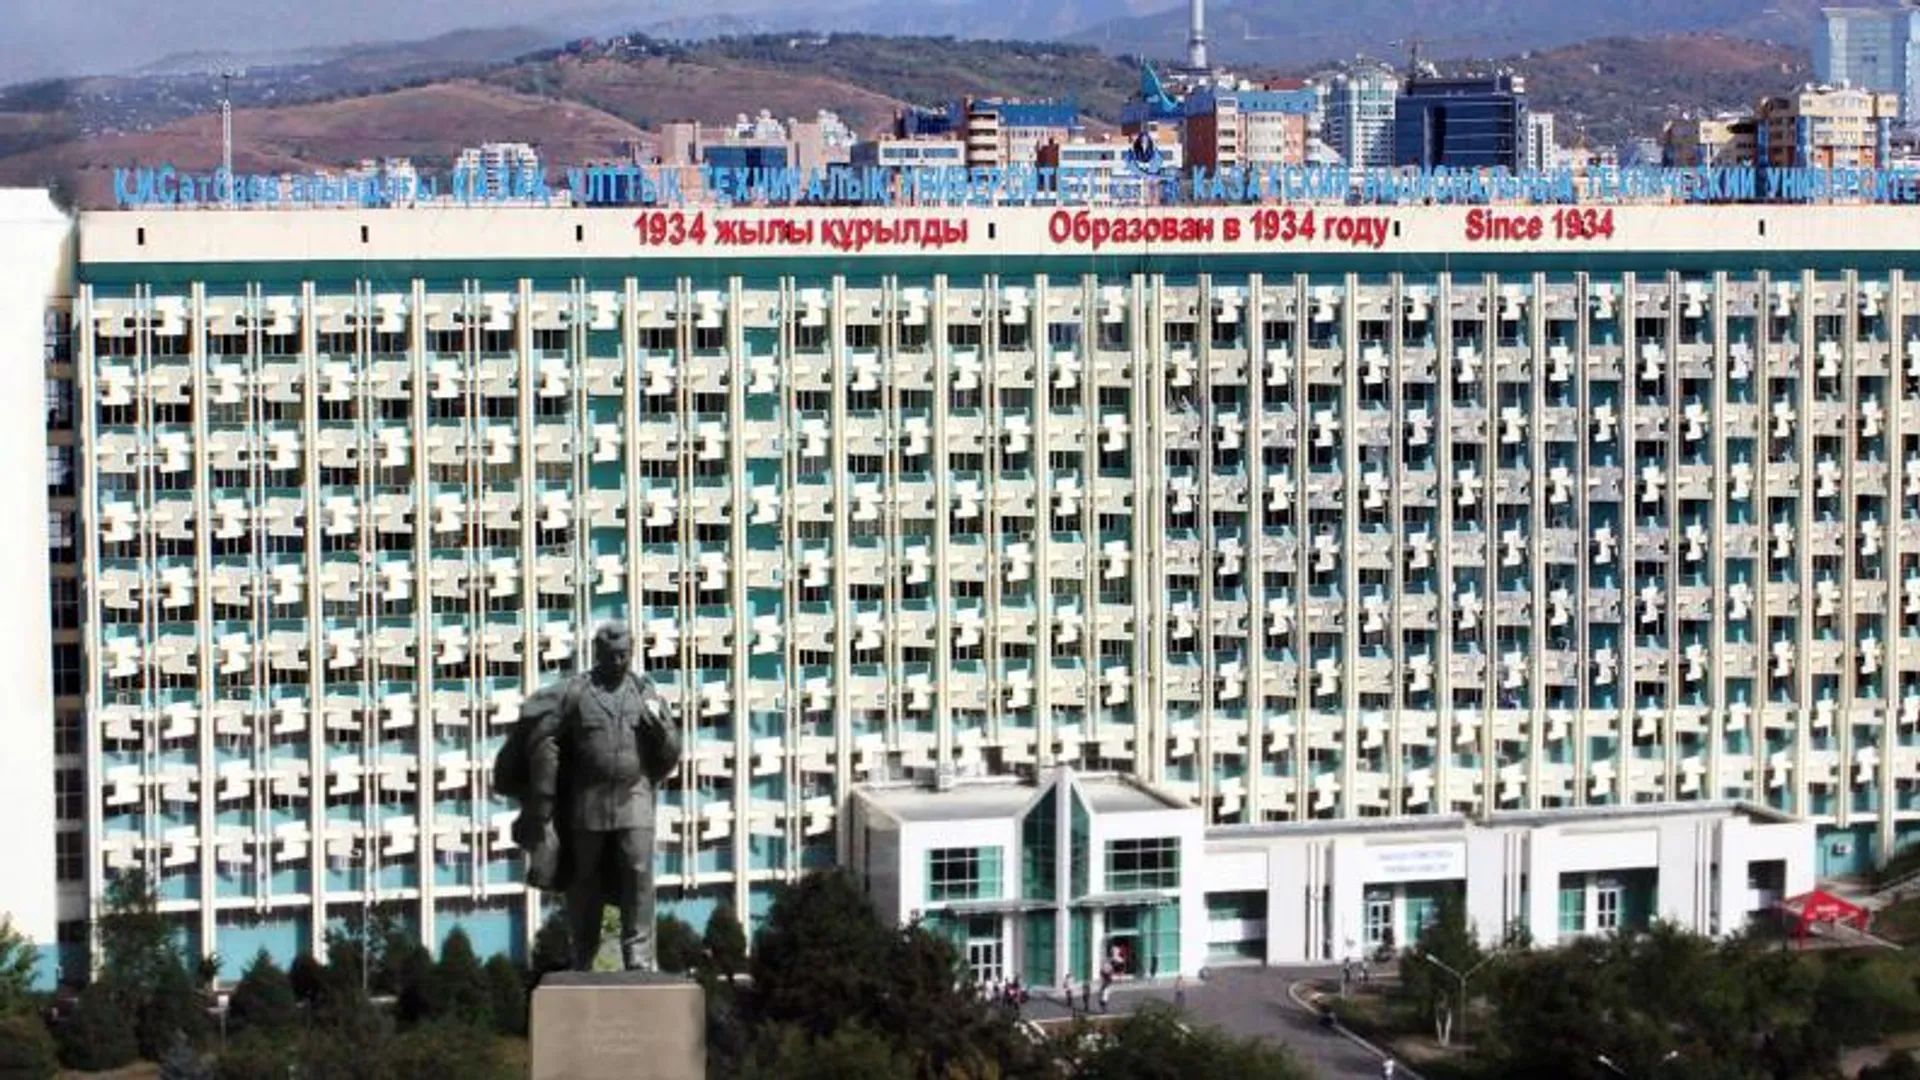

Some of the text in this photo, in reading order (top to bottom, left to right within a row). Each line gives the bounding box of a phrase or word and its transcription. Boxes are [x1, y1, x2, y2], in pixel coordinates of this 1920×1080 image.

[634, 211, 707, 244] 1934
[714, 218, 814, 244] жылы
[1050, 207, 1389, 247] Образован в 1934 году
[1465, 208, 1614, 240] Since 1934
